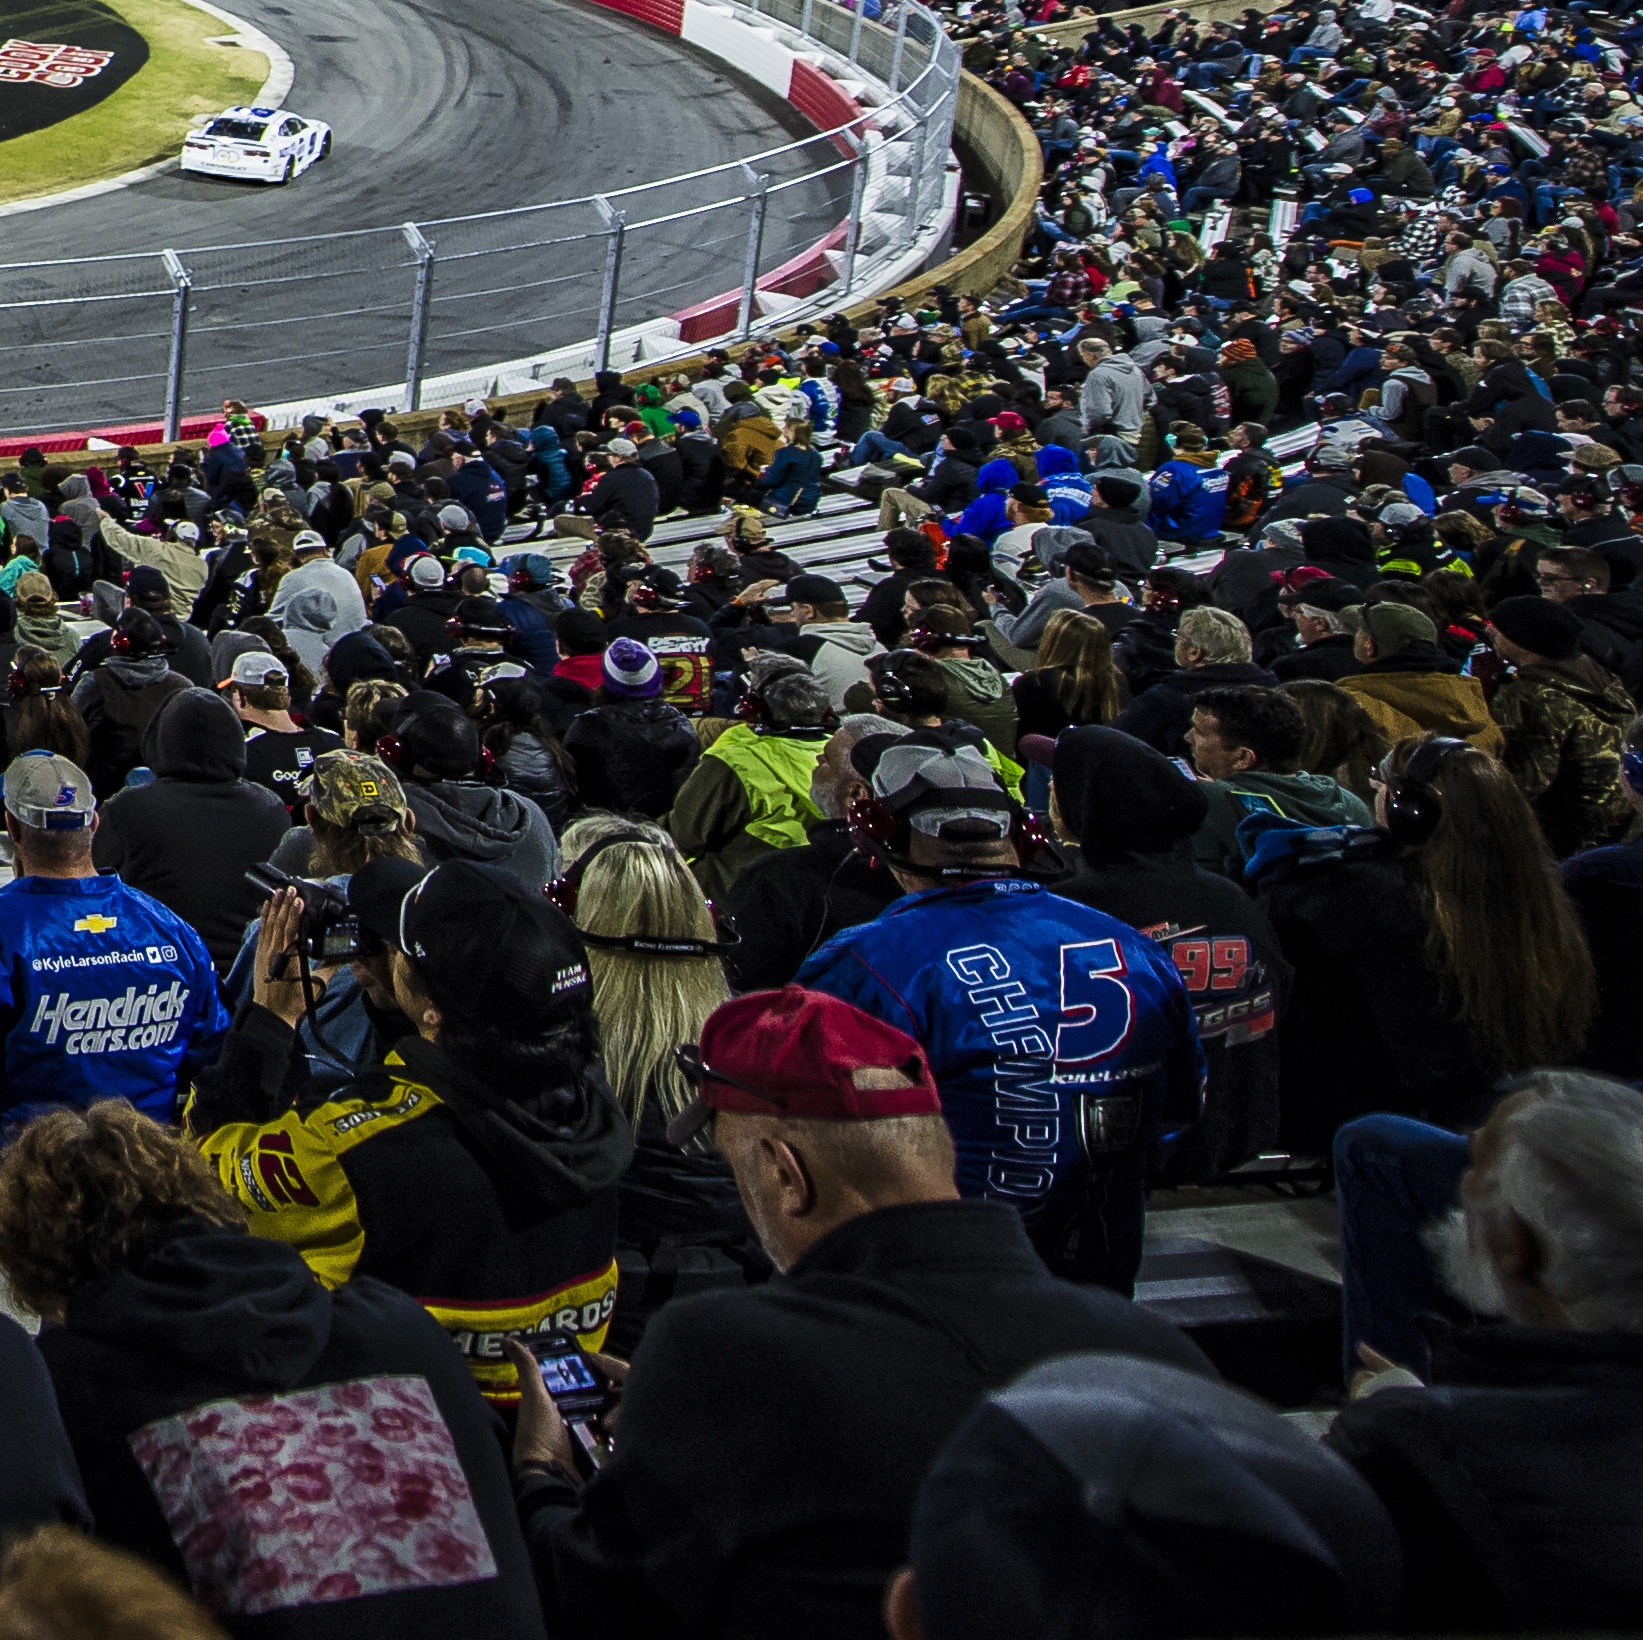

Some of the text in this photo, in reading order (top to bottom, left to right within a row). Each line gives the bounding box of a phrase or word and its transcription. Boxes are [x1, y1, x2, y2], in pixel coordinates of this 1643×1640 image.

[41, 45, 115, 78] OUT
[54, 785, 77, 807] 5
[32, 949, 146, 973] @KyleLarsonRacin
[1173, 940, 1249, 991] 99
[30, 981, 190, 1045] Hendrick
[1056, 938, 1132, 1064] 5
[66, 1021, 179, 1055] cars.com
[946, 943, 1060, 1206] CHAMPIO
[258, 1131, 322, 1209] 12
